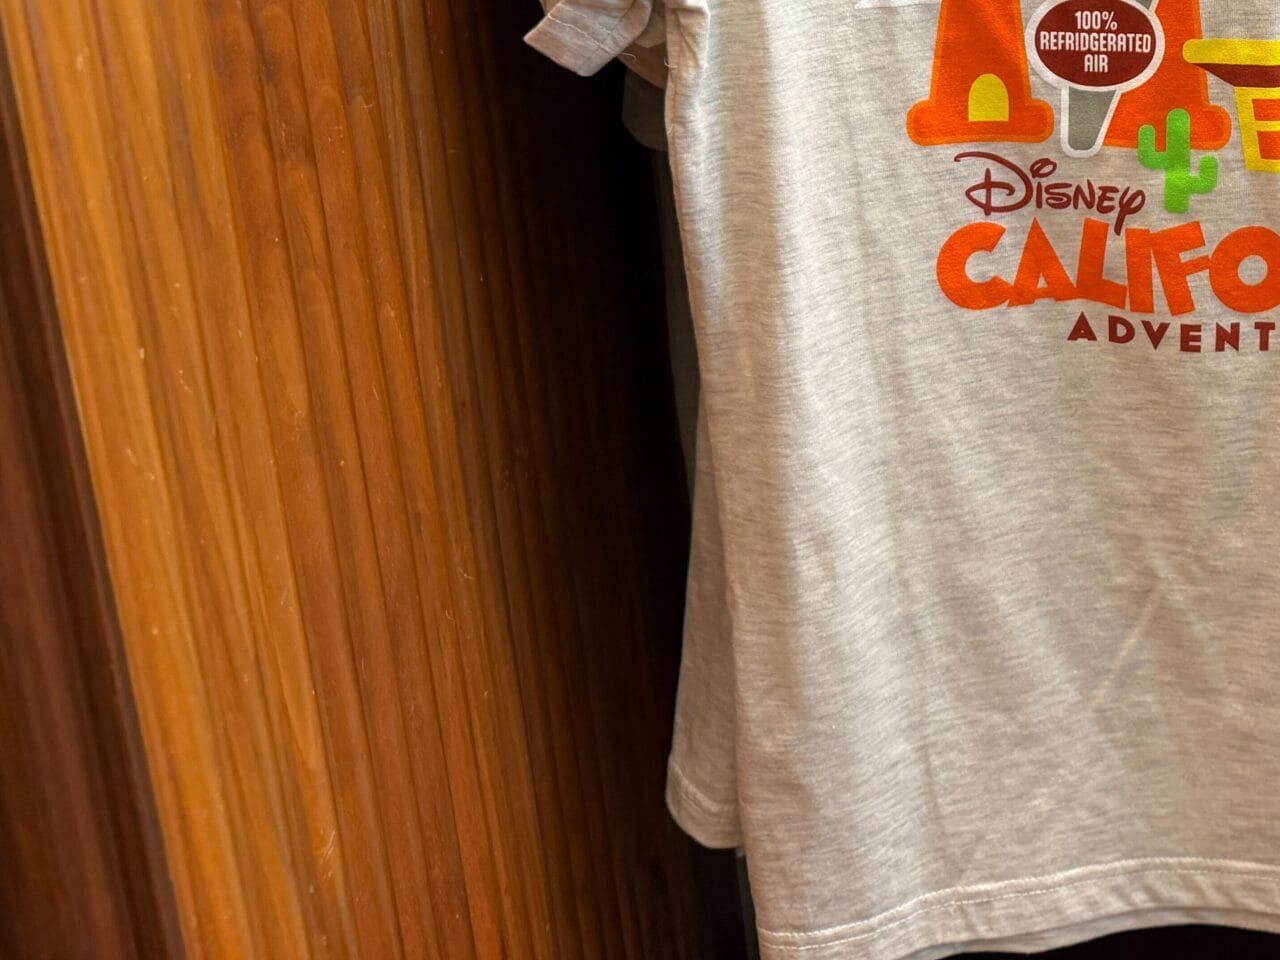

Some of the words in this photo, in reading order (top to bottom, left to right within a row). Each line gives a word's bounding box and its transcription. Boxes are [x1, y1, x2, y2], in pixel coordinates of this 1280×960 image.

[1075, 10, 1118, 31] 100%
[1040, 31, 1151, 54] REFRIDGERATED
[1084, 54, 1109, 73] AIR
[954, 151, 1147, 236] Disney
